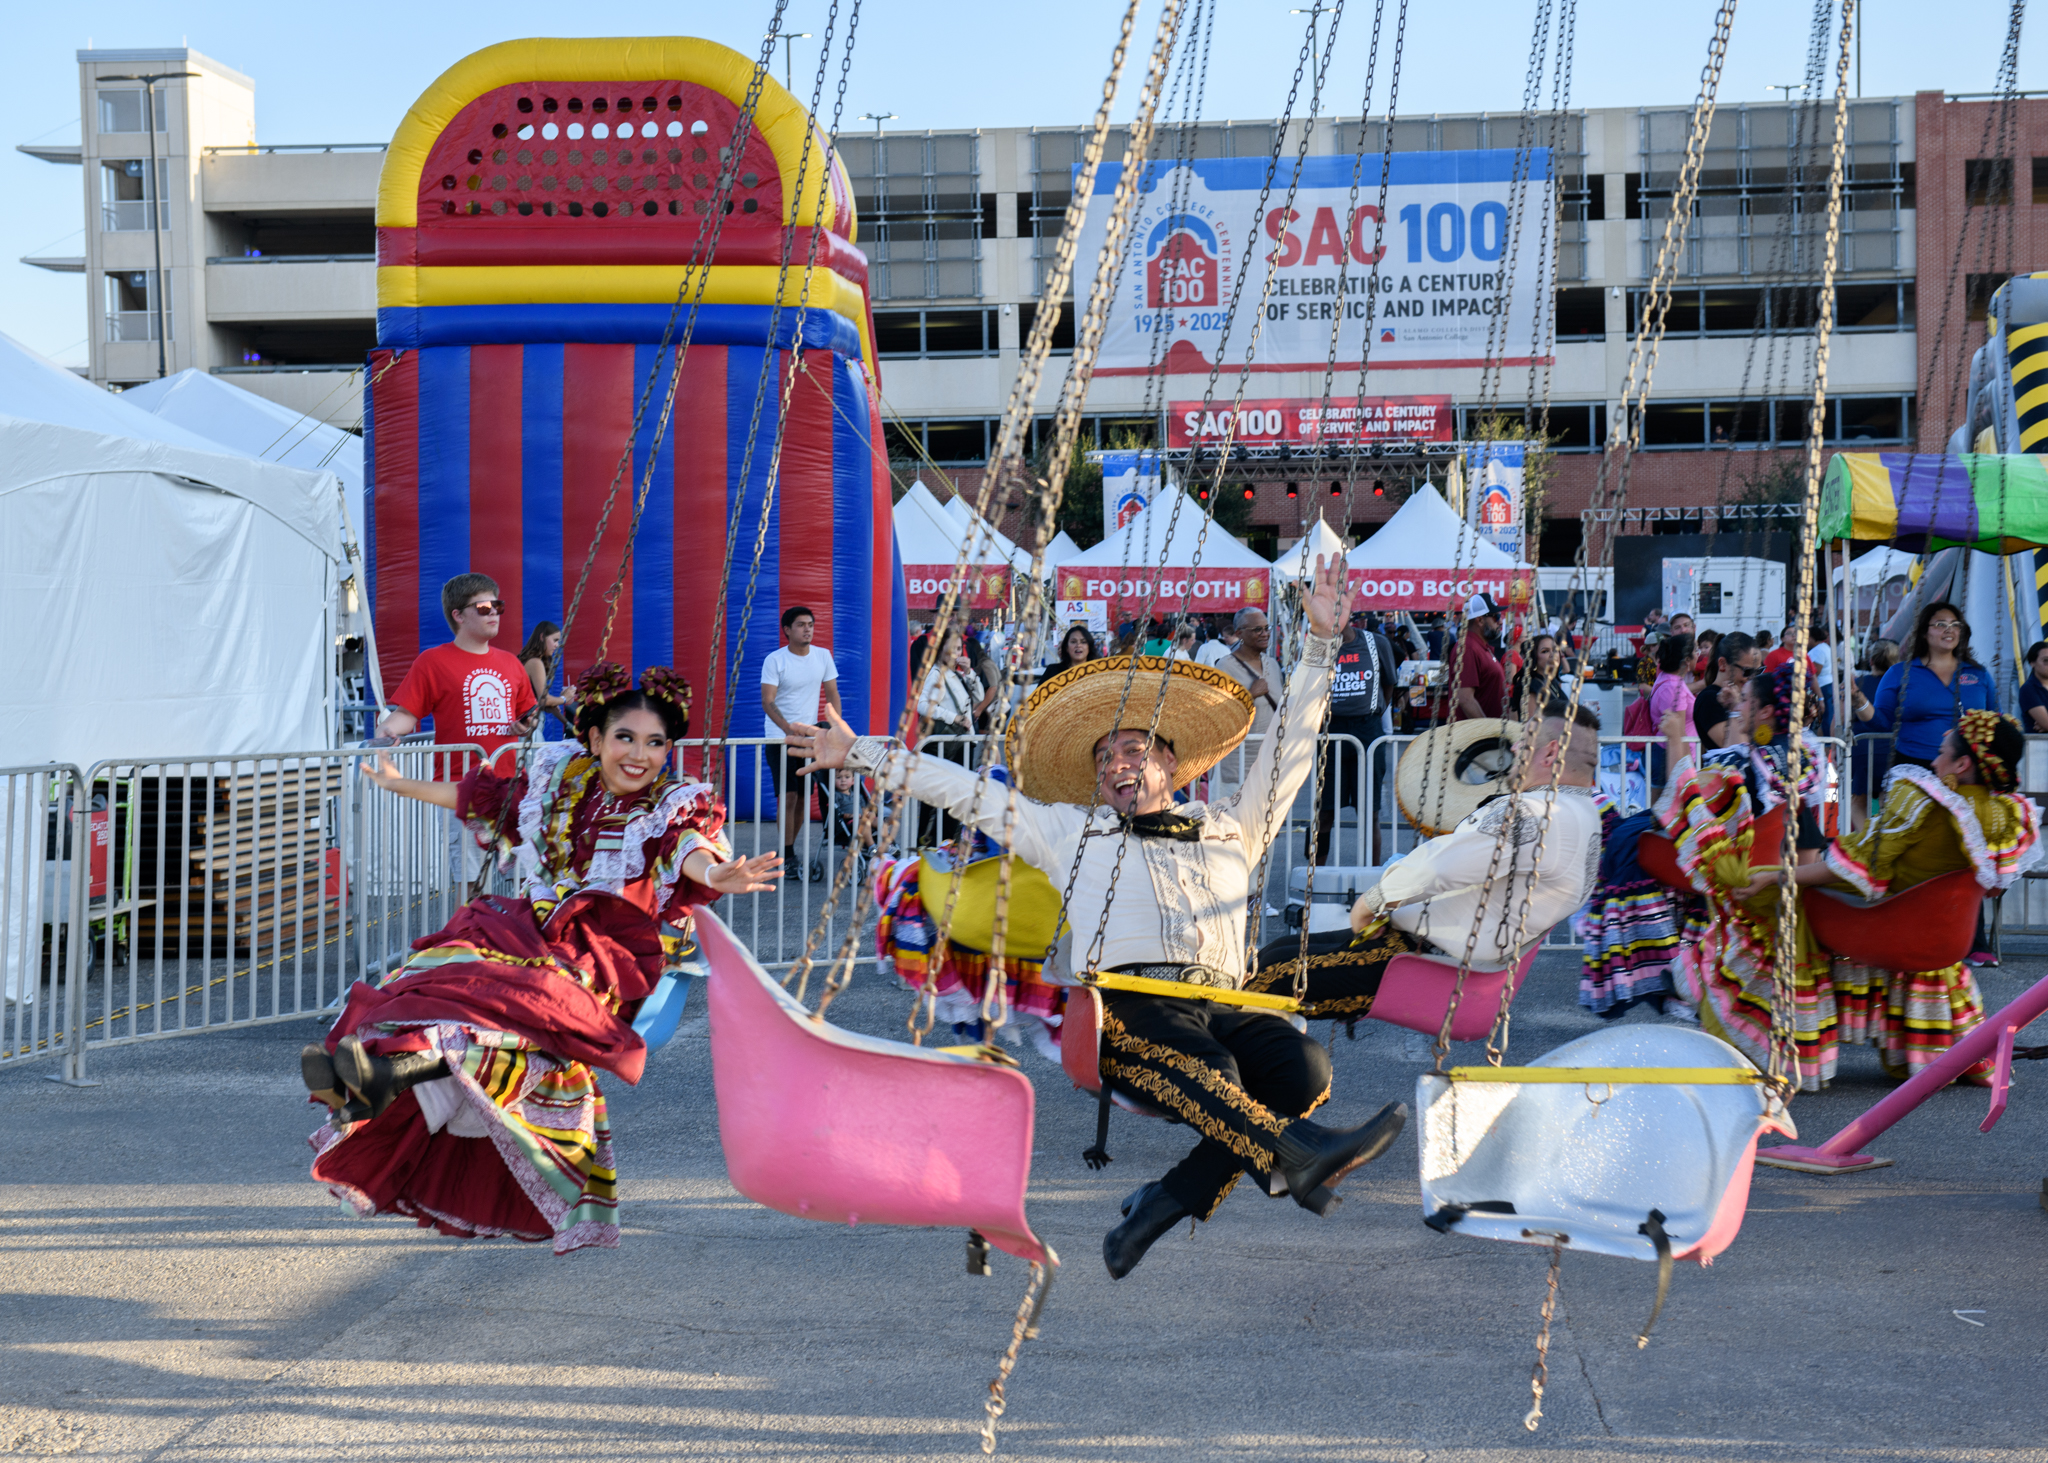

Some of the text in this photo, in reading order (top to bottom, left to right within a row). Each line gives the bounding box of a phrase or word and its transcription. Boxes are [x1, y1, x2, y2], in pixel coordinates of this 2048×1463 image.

[1265, 201, 1508, 267] SAC 100
[1133, 217, 1153, 276] ANTONIO
[1159, 257, 1206, 279] SAC
[1215, 221, 1231, 306] CENTENNIAL
[1162, 279, 1205, 304] 100
[1267, 272, 1507, 297] CELEBRATING A CENTURY
[1133, 284, 1143, 309] SAN
[1266, 297, 1505, 321] OF SERVICE AND IMPACT
[1134, 312, 1230, 333] 1925 2025
[1299, 405, 1437, 421] CELEBRATING A CENTURY
[1184, 409, 1283, 438] SAC 100
[1298, 419, 1436, 434] OF SERVICE AND IMPACT
[1486, 502, 1506, 512] SAC
[1486, 512, 1506, 522] 100
[1479, 526, 1517, 534] 925 2025
[1498, 542, 1517, 552] 100
[909, 578, 980, 595] BOOTH
[1086, 579, 1240, 598] FOOD BOOTH
[1422, 580, 1504, 598] BOOTH
[1066, 601, 1091, 613] ASL
[1337, 653, 1360, 664] ARE
[462, 674, 473, 707] ANTONIO
[471, 668, 502, 679] COLLEGE
[478, 696, 500, 707] SAC
[480, 708, 501, 720] 100
[465, 725, 511, 737] 1925 202
